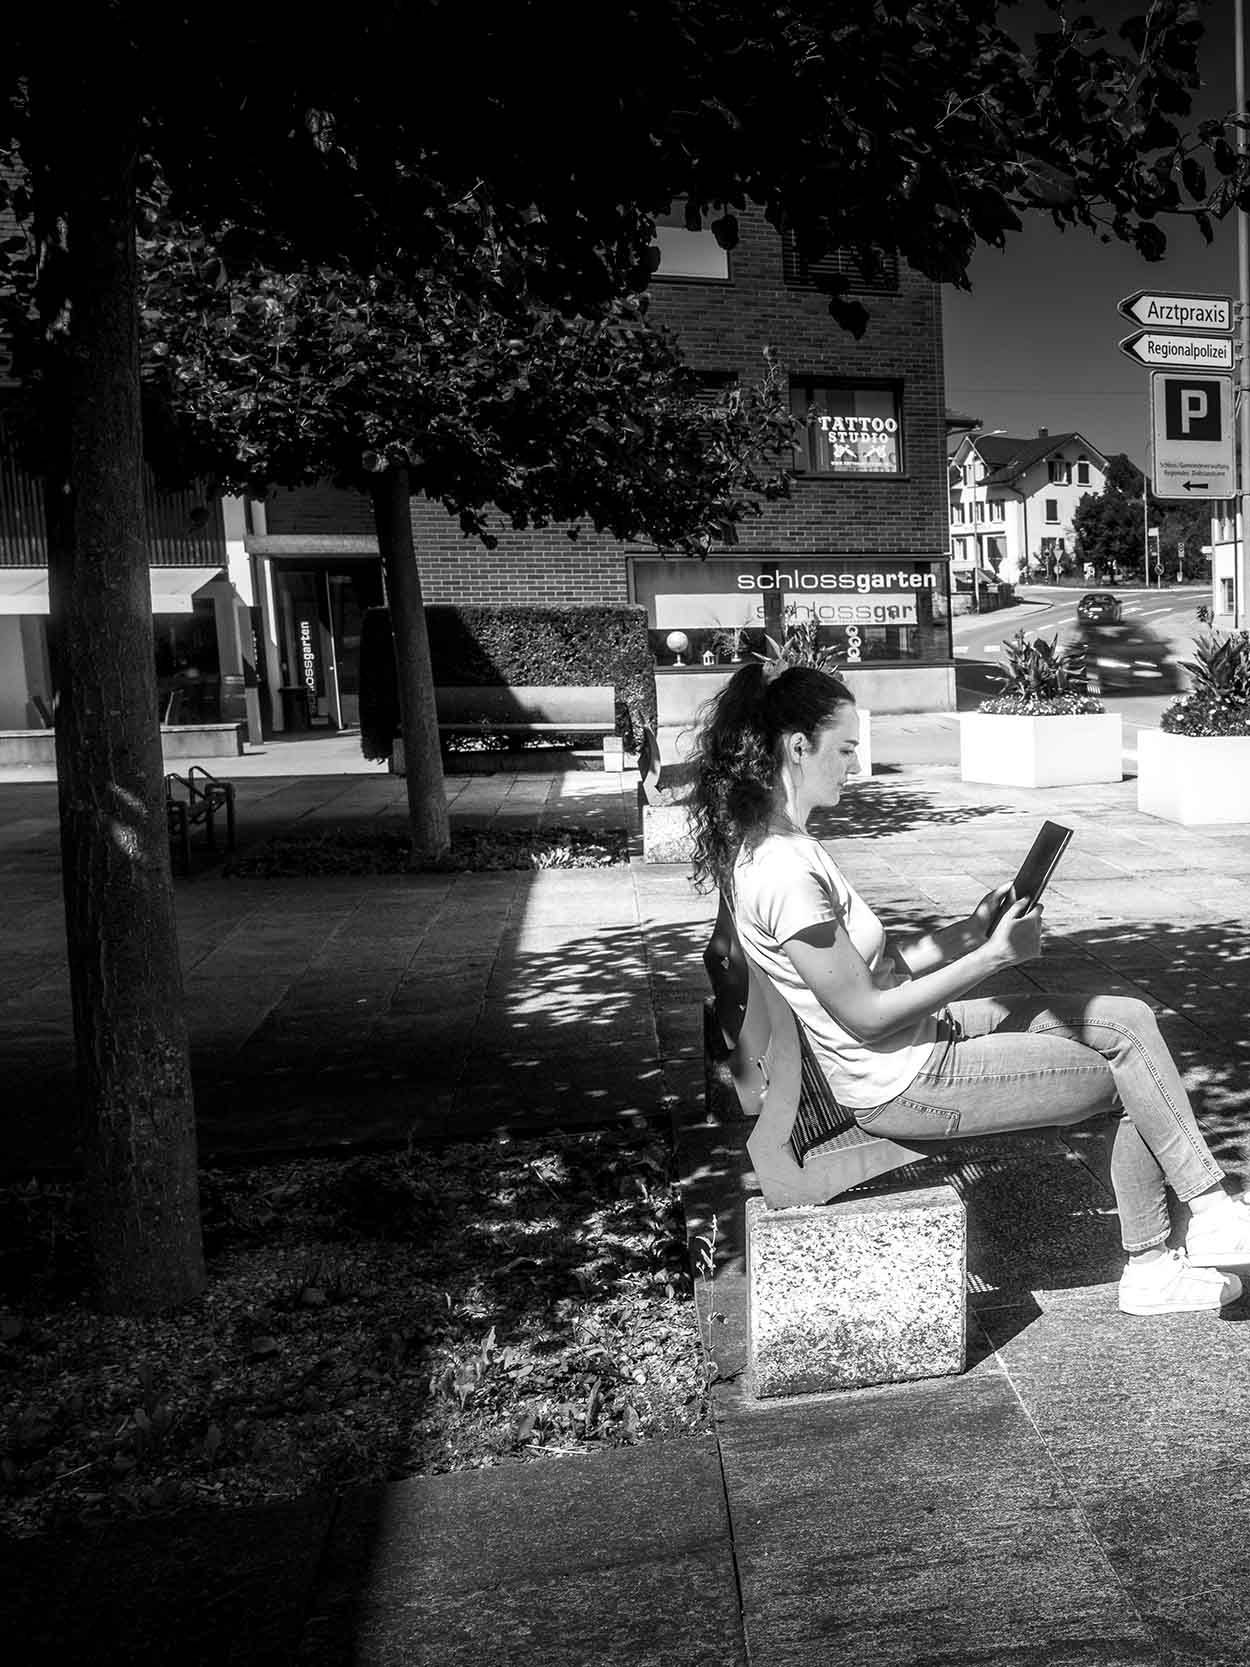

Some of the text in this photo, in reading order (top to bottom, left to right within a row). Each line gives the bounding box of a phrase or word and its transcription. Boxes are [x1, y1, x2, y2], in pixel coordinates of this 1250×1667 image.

[1147, 301, 1225, 324] Arztpraxis
[1147, 340, 1227, 360] Regionalpolizei
[1180, 389, 1208, 433] P
[818, 416, 898, 432] TATTOO
[828, 431, 889, 443] STUDIO
[737, 569, 937, 593] schlossgarten
